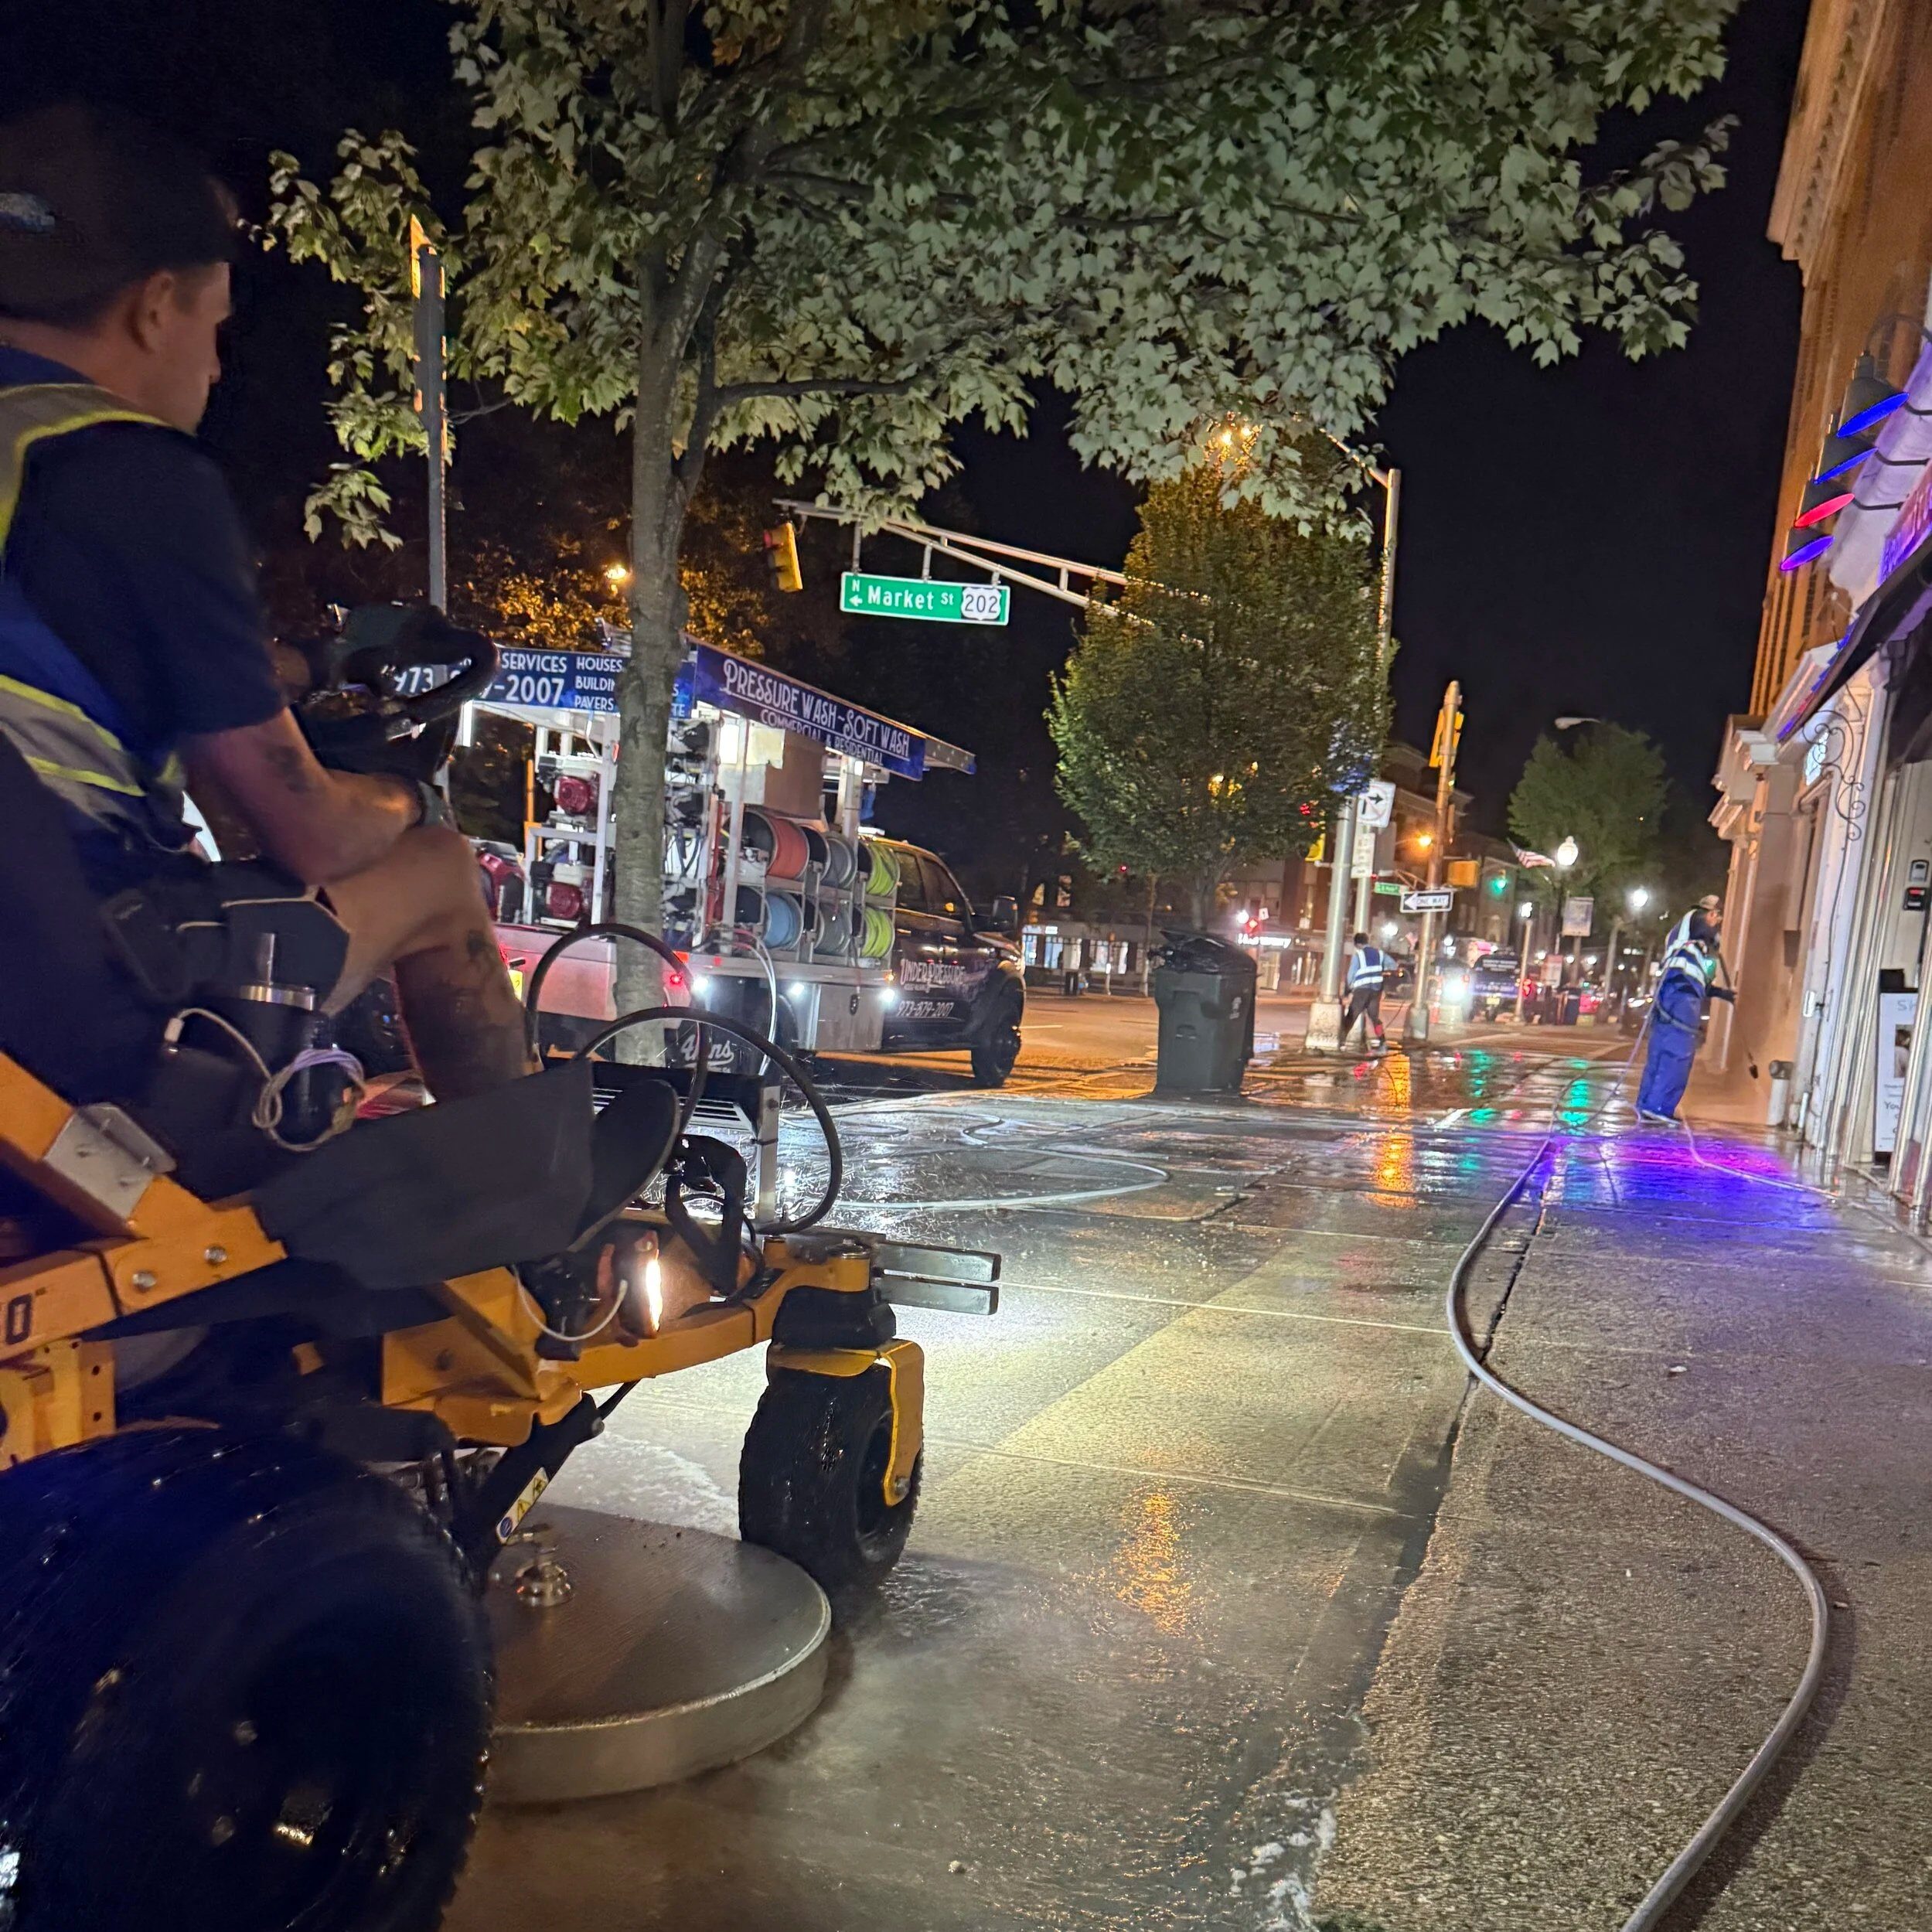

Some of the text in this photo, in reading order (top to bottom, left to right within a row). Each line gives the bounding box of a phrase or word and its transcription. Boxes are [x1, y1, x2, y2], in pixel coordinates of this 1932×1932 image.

[852, 580, 998, 613] N Market St 202
[502, 653, 567, 673] SERVICES
[574, 696, 615, 710] PAVERS
[721, 659, 799, 715] PRESSURE
[881, 724, 910, 757] WASH
[834, 737, 884, 765] RESIDENTIAL
[900, 959, 966, 986] UNDER PRESSURE
